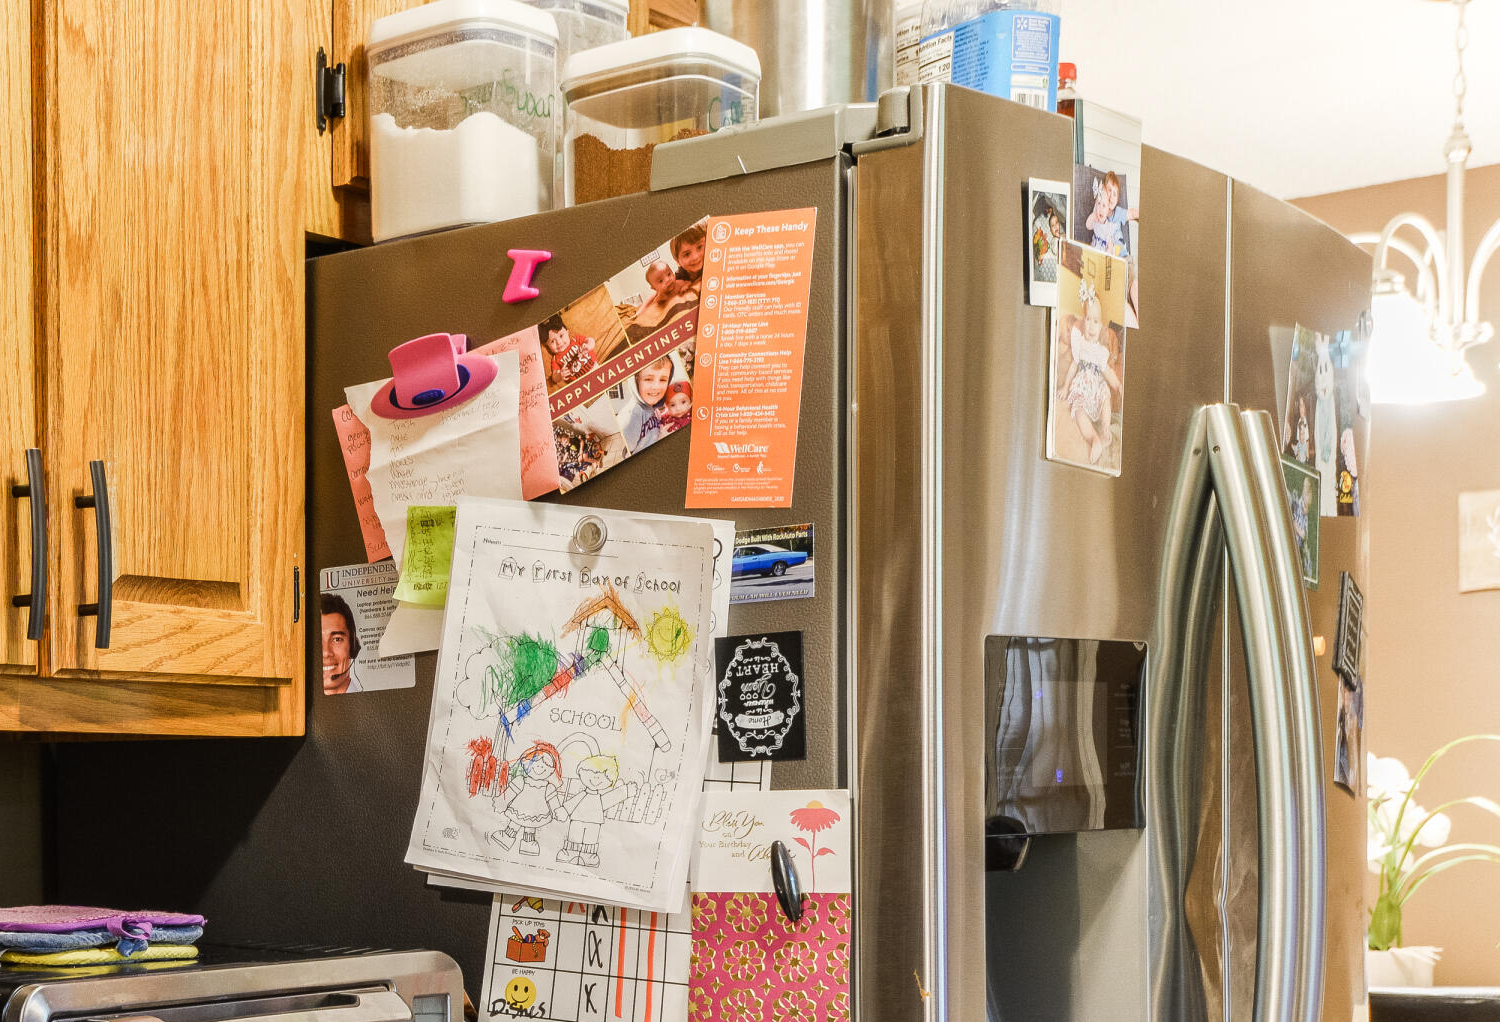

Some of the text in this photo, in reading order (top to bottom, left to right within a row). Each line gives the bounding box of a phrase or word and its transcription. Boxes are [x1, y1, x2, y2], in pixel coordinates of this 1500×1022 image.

[938, 62, 950, 73] 120
[734, 220, 809, 237] Keep These Handy
[549, 381, 591, 414] HAPPY
[597, 320, 694, 382] VALENTINE'S
[729, 443, 768, 453] WellCare
[342, 564, 396, 577] INDEPENDEN
[342, 577, 386, 587] UNIVERSITY
[581, 572, 609, 587] Day
[614, 575, 629, 588] of
[636, 573, 681, 595] School
[357, 588, 378, 597] Need
[736, 663, 779, 676] HEART
[549, 708, 622, 731] SCHOOL
[719, 841, 751, 849] Birthday
